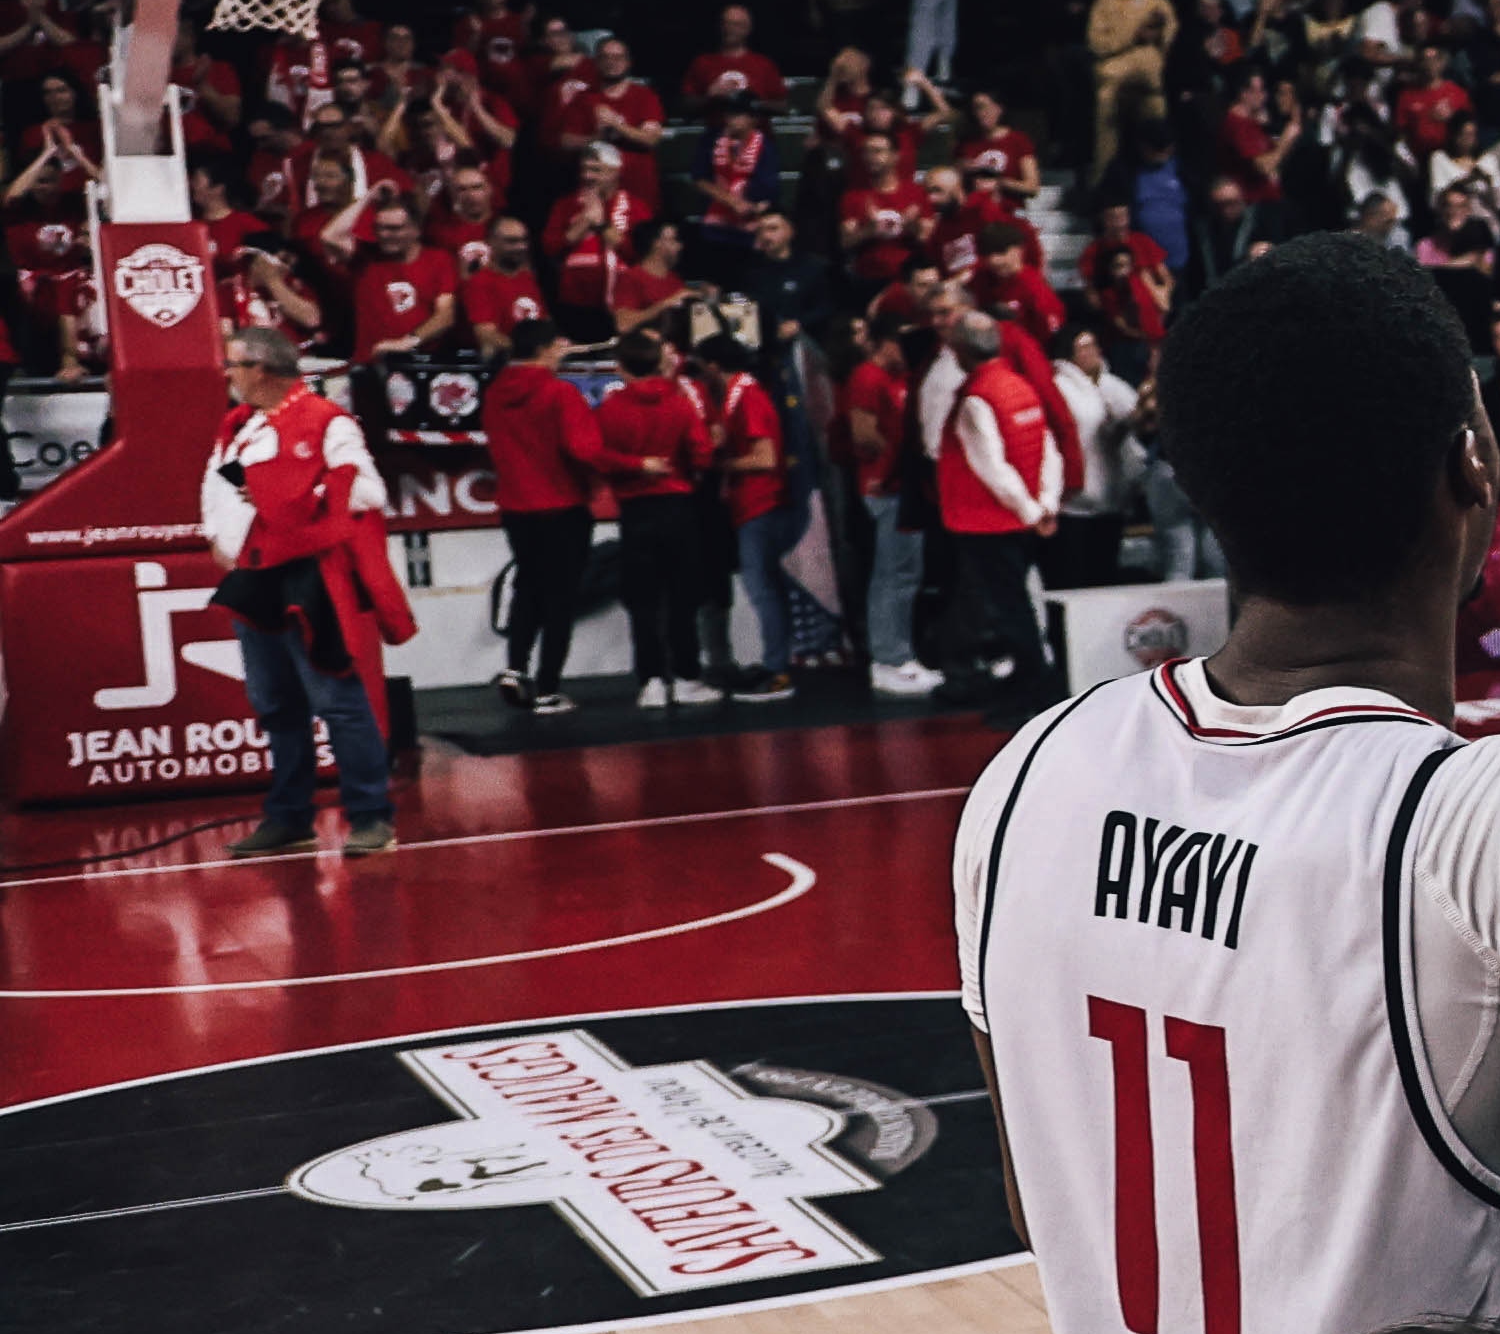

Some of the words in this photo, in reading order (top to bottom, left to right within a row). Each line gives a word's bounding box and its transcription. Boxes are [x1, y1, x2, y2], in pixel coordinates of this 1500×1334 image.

[67, 724, 175, 769] JEAN
[88, 744, 337, 786] AUTOMOBIS
[1094, 809, 1260, 951] AYAYI
[440, 1040, 642, 1132] MAUGES
[559, 1123, 671, 1163] DES
[570, 1157, 817, 1278] SAVEURS
